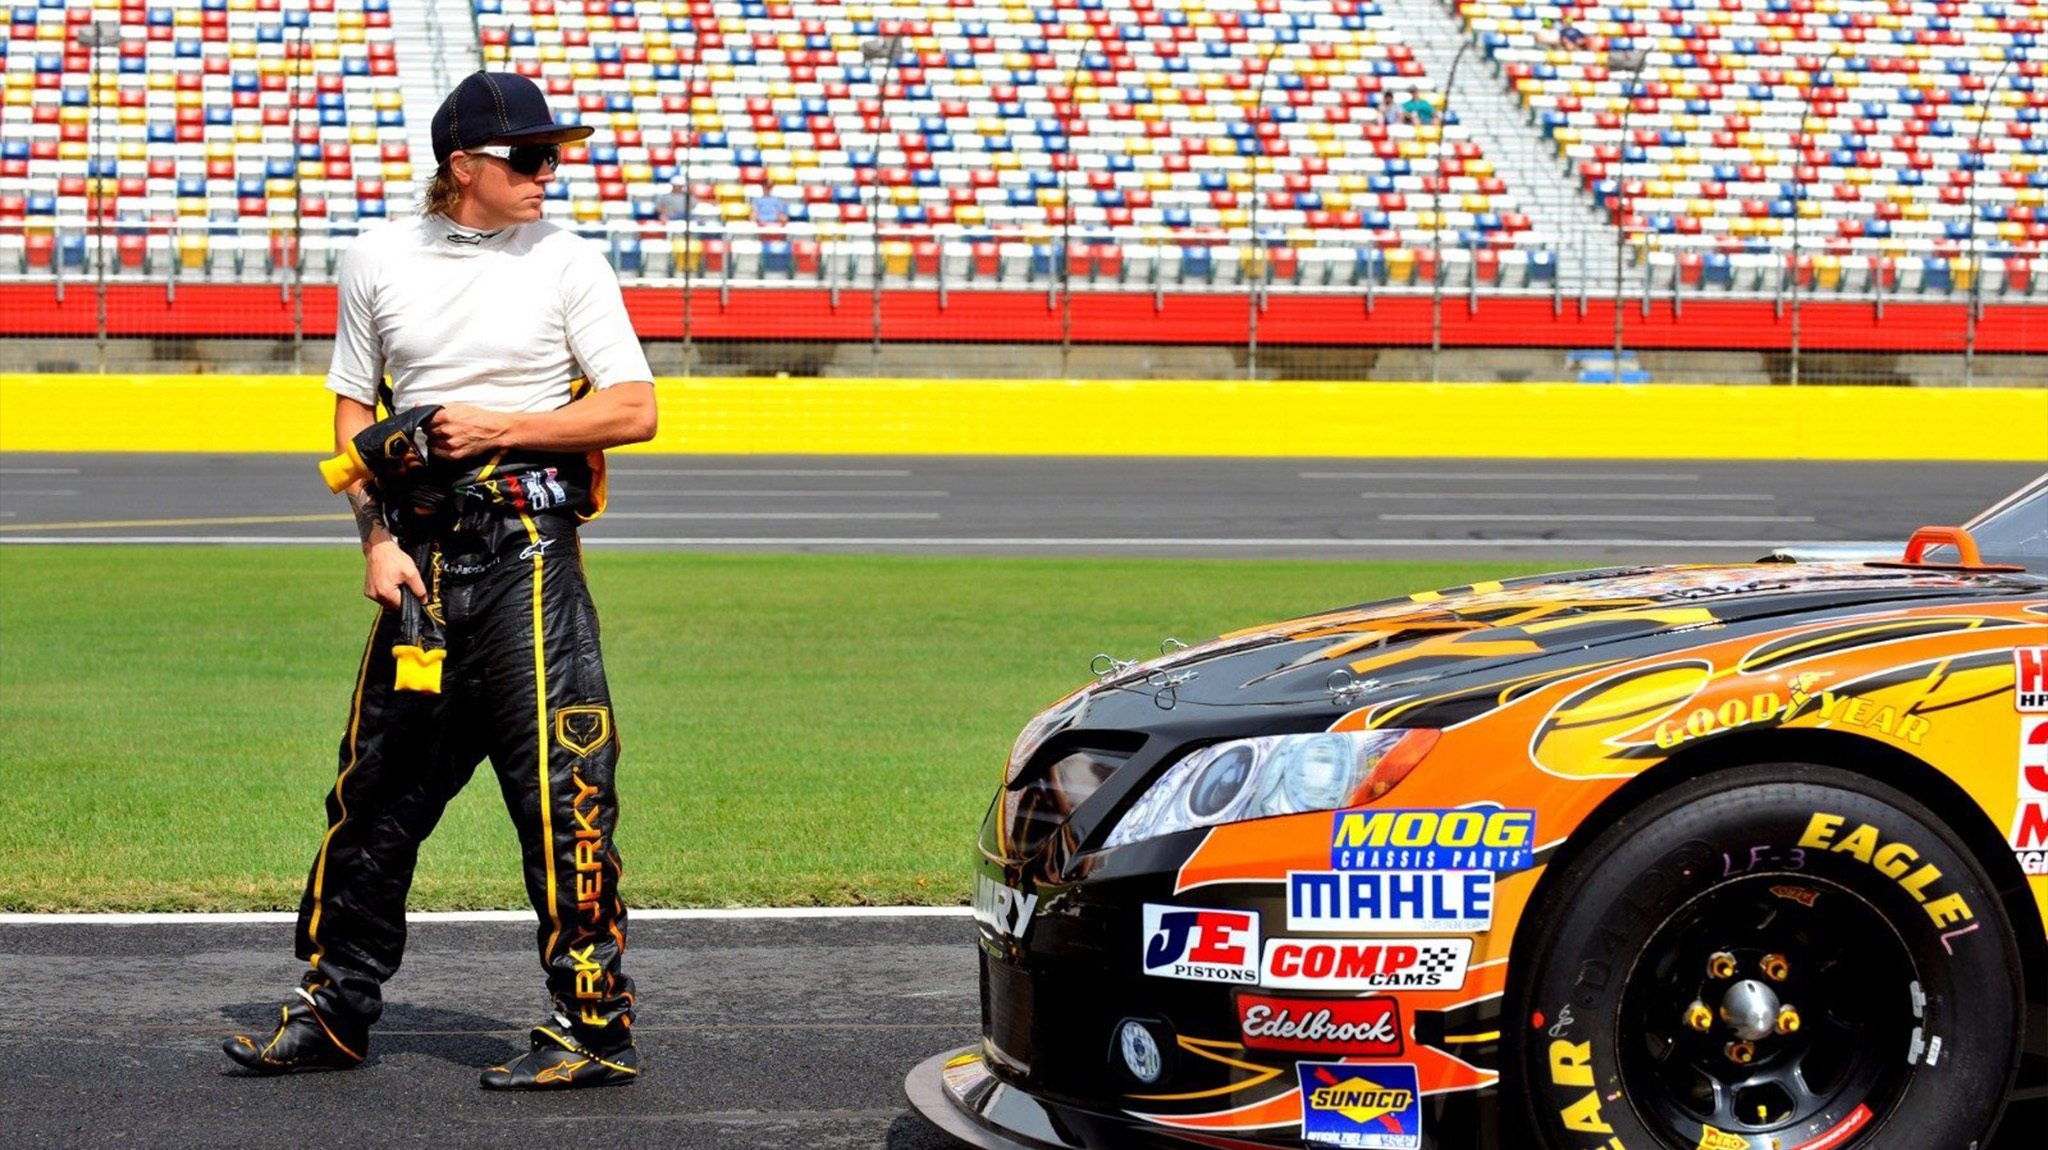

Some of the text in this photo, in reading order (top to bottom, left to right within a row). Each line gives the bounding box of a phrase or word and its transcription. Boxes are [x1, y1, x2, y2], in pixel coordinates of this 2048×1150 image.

[1333, 812, 1532, 848] MOOG
[573, 773, 603, 924] JERKY
[1340, 850, 1521, 868] CHASSIS PARTS
[1723, 845, 1806, 877] LF-3
[1797, 812, 1974, 929] EAGLE
[1291, 874, 1491, 919] MAHLE
[1146, 911, 1251, 970] JE
[1174, 964, 1257, 982] PISTONS
[1270, 944, 1418, 979] COMP
[1368, 973, 1442, 986] CAMS
[1241, 1004, 1396, 1043] Edelbrock
[1315, 1089, 1409, 1109] SUNOCO
[1707, 1133, 1743, 1149] AERO
